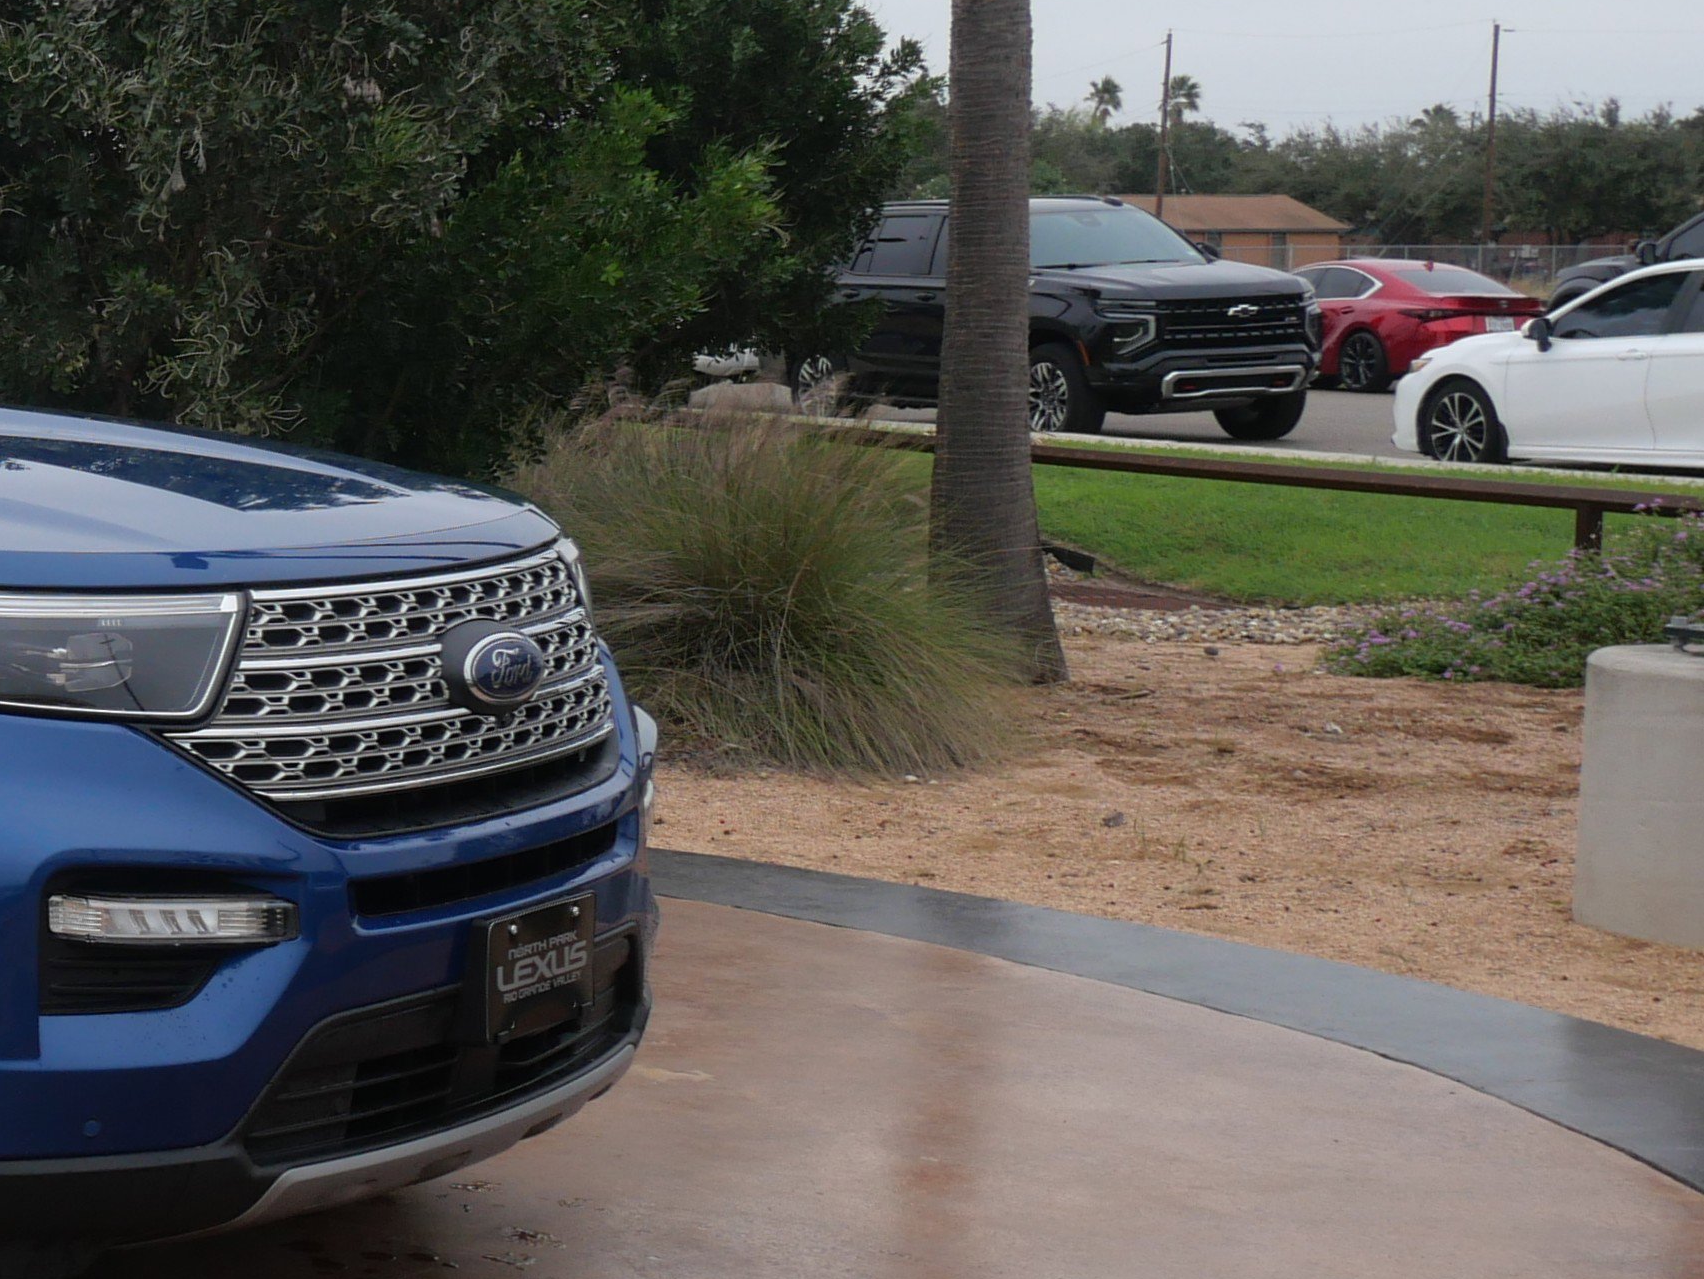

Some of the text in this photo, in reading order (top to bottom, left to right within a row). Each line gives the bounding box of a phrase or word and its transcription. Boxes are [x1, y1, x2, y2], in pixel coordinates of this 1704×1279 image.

[492, 647, 532, 689] Ford
[548, 930, 577, 949] PARK
[497, 940, 588, 992] LEXUS
